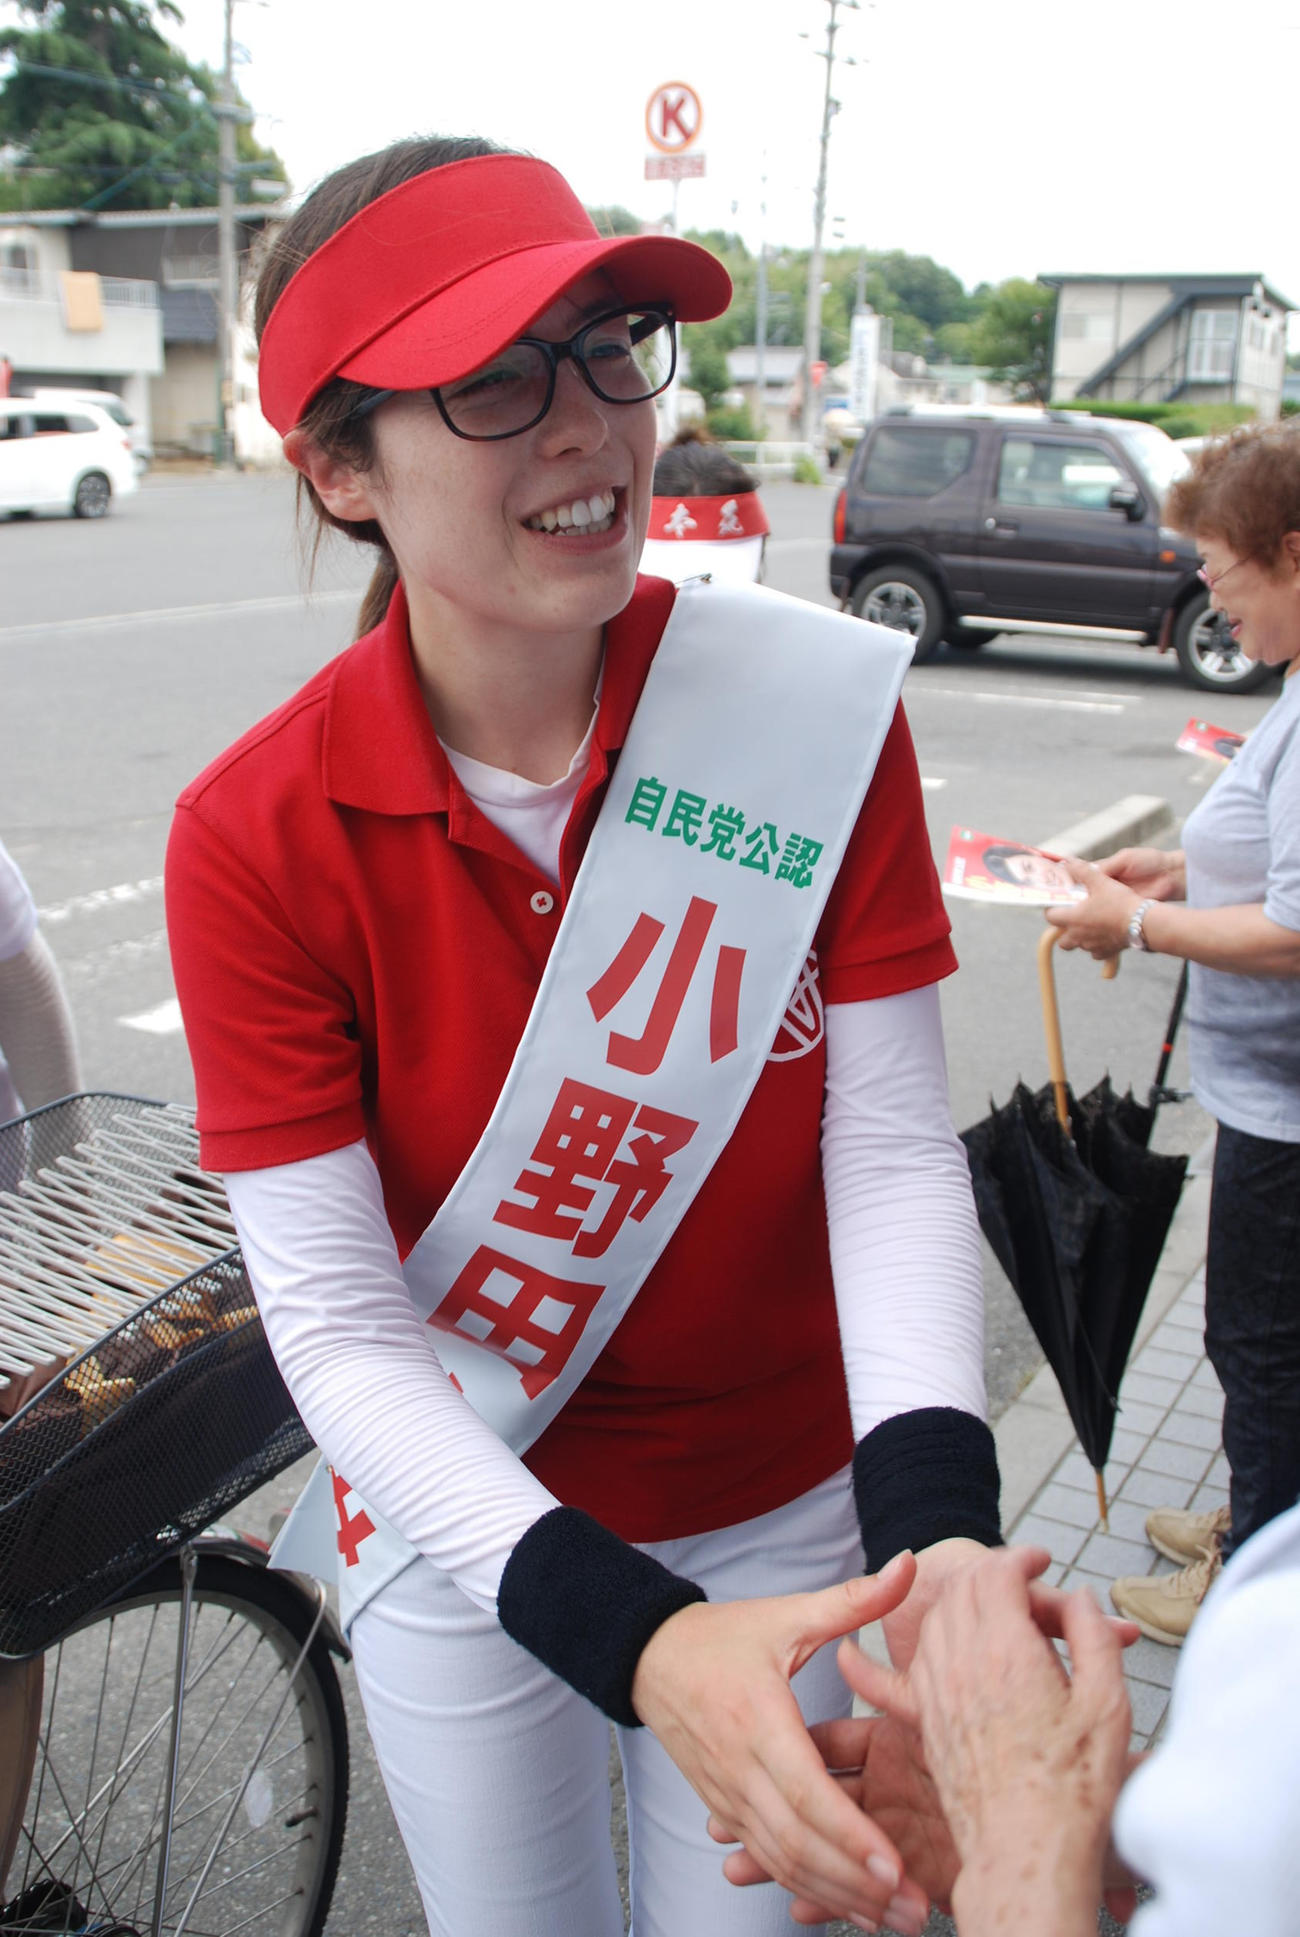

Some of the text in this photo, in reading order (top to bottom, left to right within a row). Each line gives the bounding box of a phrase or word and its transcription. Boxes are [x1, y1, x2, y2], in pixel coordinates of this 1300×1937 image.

[661, 97, 692, 141] K
[624, 776, 824, 889] 自民党公認
[426, 895, 748, 1401] 小野田
